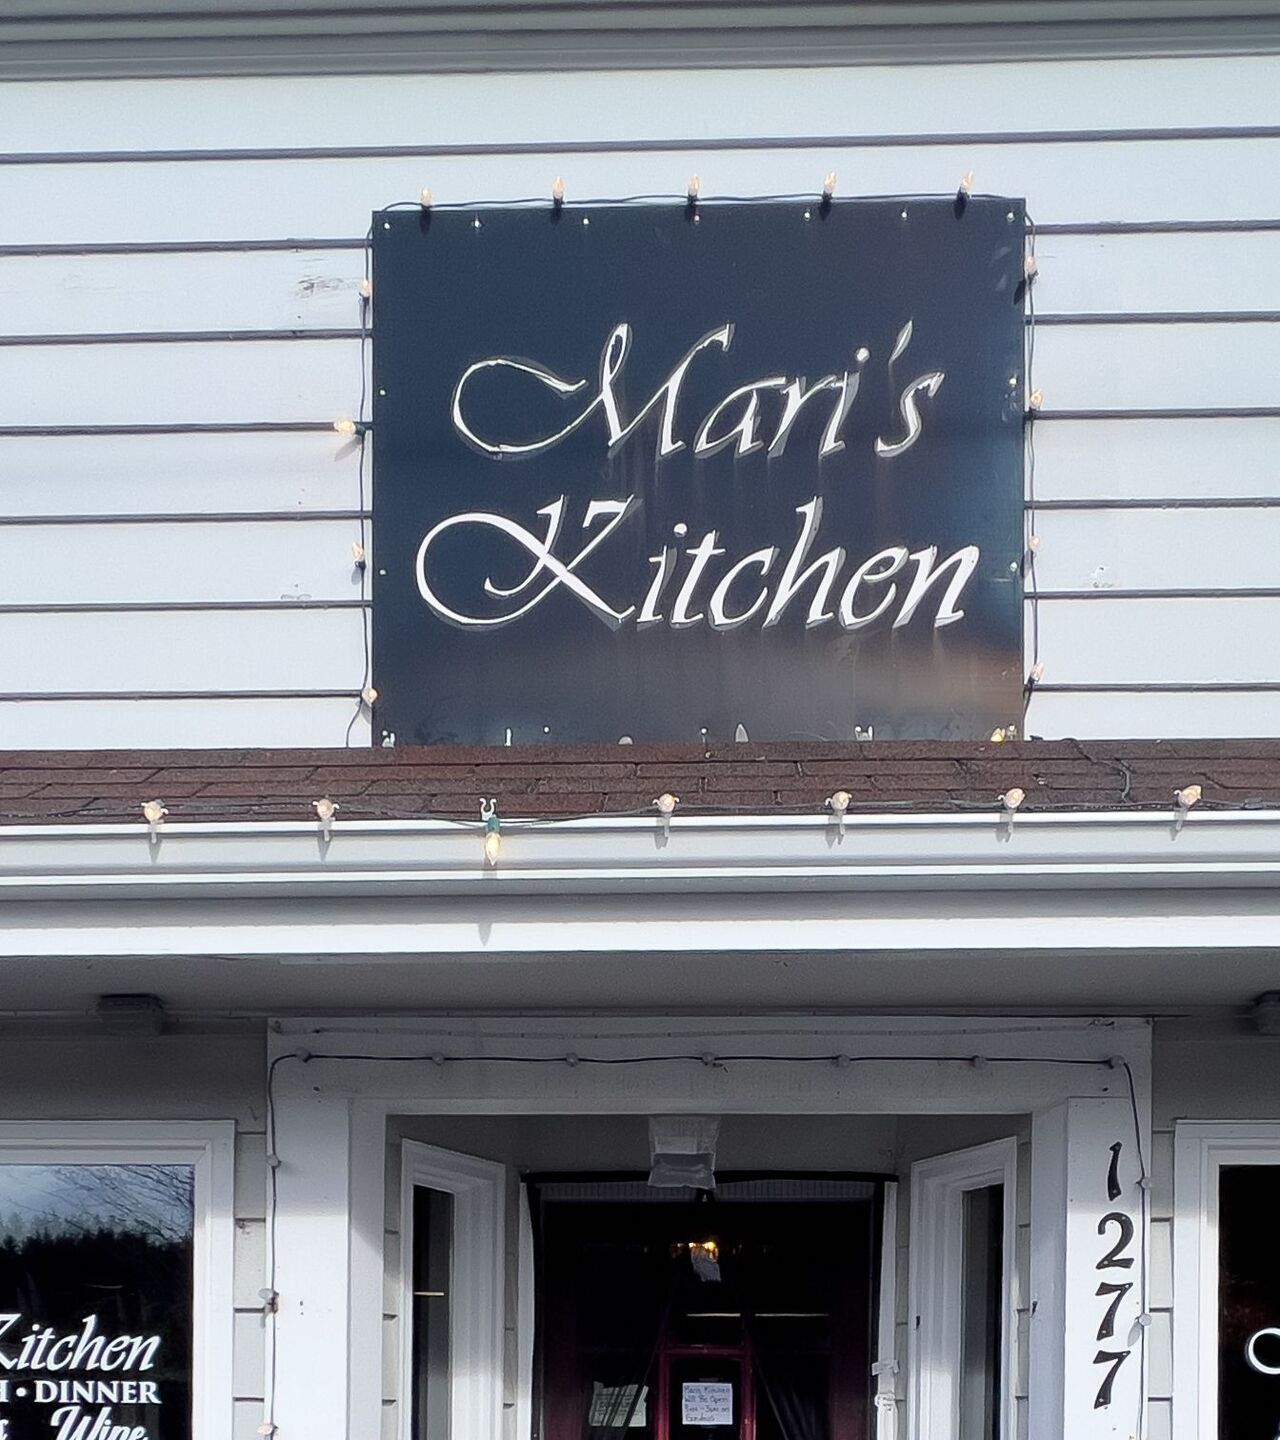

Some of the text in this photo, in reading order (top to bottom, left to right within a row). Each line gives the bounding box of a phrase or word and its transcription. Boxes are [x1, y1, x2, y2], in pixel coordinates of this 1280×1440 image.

[452, 319, 945, 457] Mari's
[417, 495, 980, 628] Kitchen
[1093, 1141, 1134, 1409] 1277
[34, 1380, 161, 1403] DINNER
